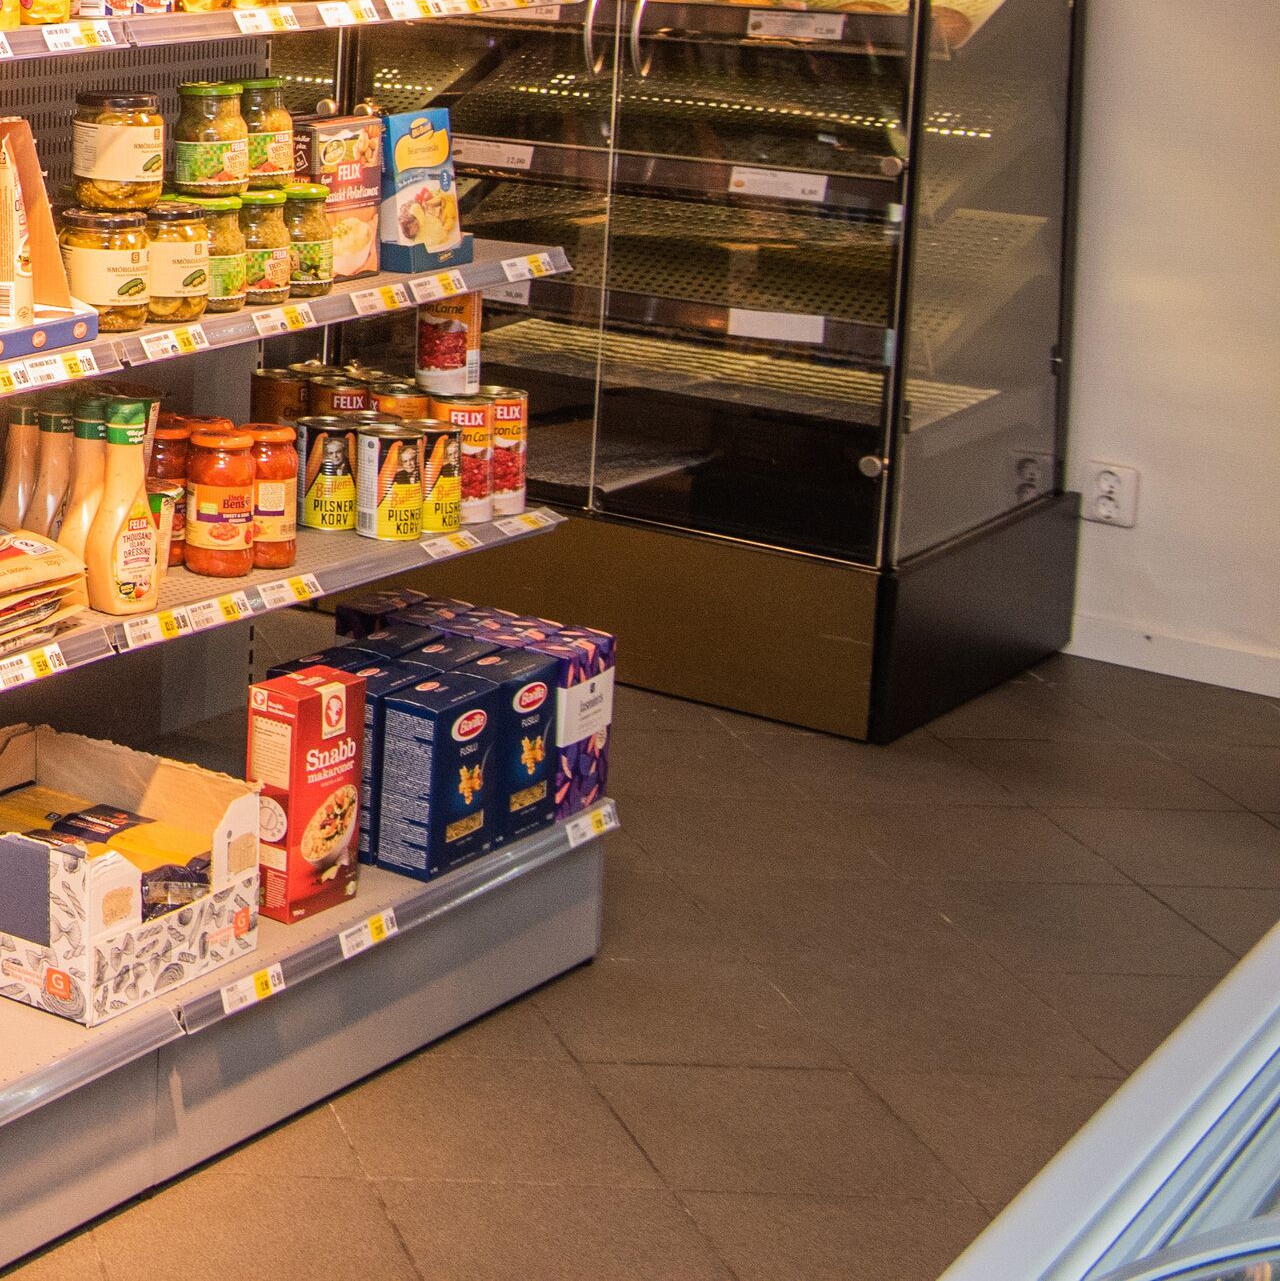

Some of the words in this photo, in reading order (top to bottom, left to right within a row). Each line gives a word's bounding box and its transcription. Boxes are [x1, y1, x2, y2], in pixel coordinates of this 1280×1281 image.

[338, 164, 361, 180] FELIX
[333, 396, 364, 409] FELIX
[451, 412, 483, 425] FELIX
[314, 500, 353, 512] PILSNER
[129, 519, 147, 529] FELIX
[321, 513, 348, 525] KORV
[123, 532, 152, 541] THOUSAND
[124, 548, 151, 559] DRESSING
[306, 737, 356, 772] Snabb
[307, 759, 355, 785] makaroner
